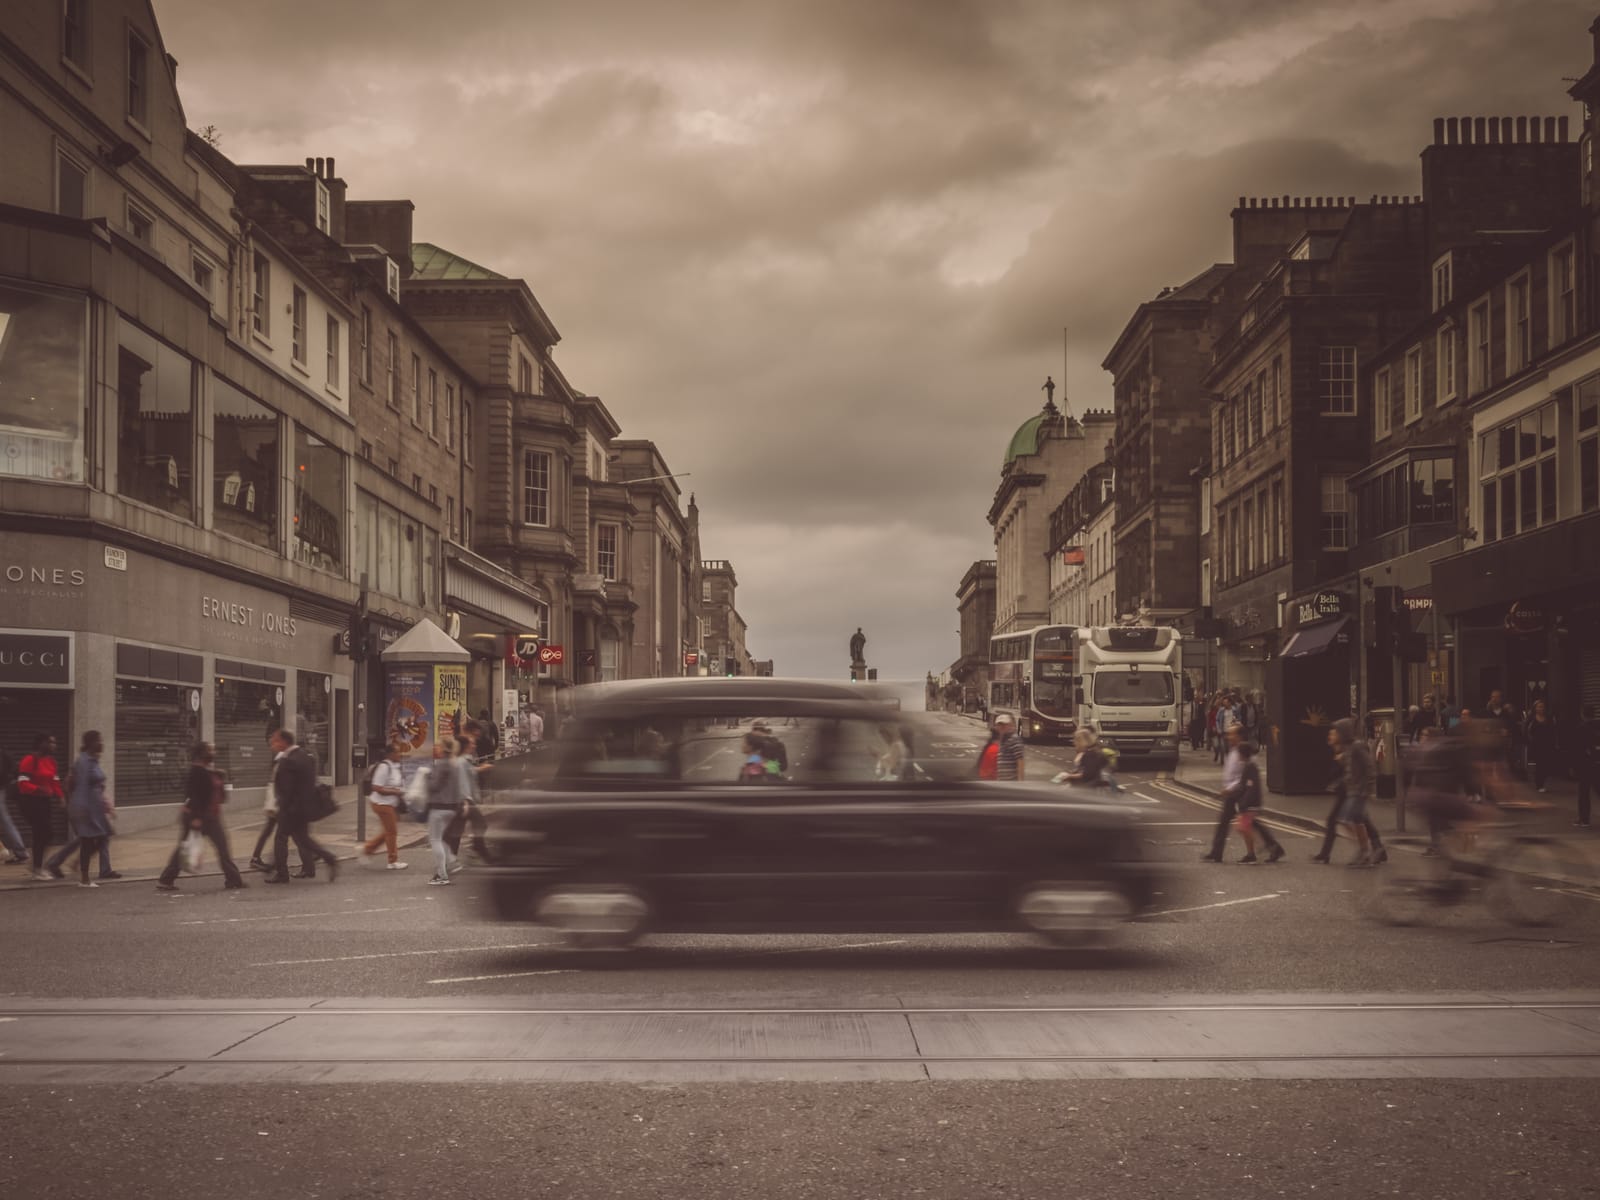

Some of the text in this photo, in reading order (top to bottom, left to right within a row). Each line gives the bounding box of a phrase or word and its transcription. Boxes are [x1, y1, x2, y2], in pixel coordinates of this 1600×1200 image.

[1320, 594, 1339, 603] Bella
[1320, 604, 1340, 613] Italia
[202, 596, 253, 626] ERNEST
[260, 612, 296, 637] JONES
[519, 642, 537, 655] JD
[0, 650, 64, 667] UCCI
